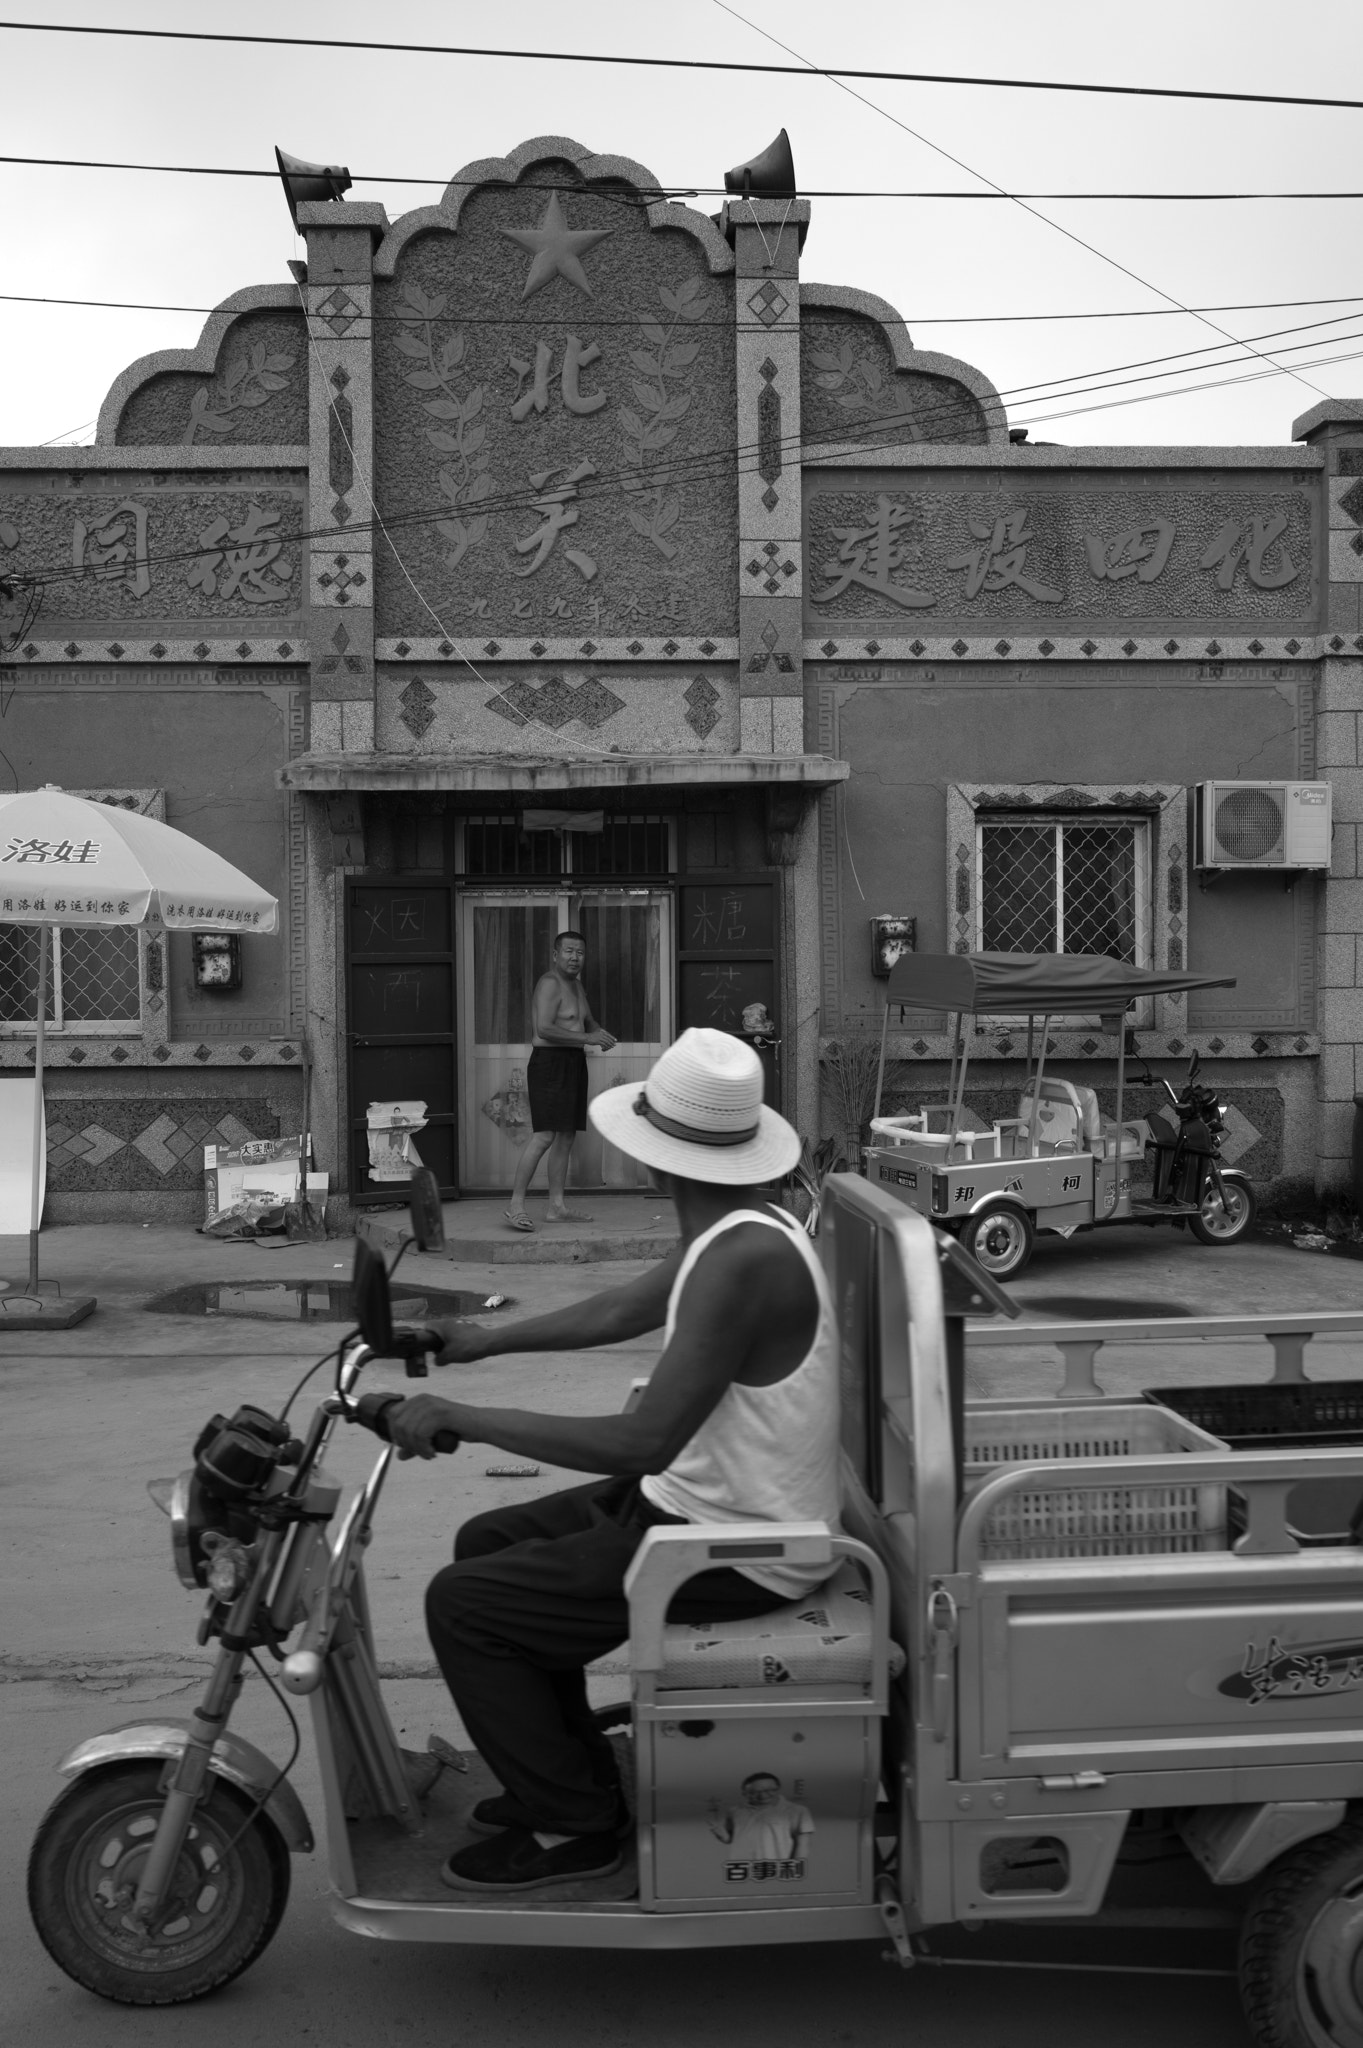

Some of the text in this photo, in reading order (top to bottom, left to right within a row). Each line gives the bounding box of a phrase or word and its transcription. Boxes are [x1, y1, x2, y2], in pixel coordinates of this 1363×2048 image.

[814, 493, 1299, 609] 建设四化
[431, 592, 688, 624] 一九七九年冬建
[1, 838, 98, 864] 洛娃
[363, 898, 427, 946] 烟
[692, 890, 748, 945] 糖
[241, 1142, 274, 1156] 大实惠
[954, 1175, 1081, 1202] 邦 柯
[724, 1860, 805, 1882] 百事利
